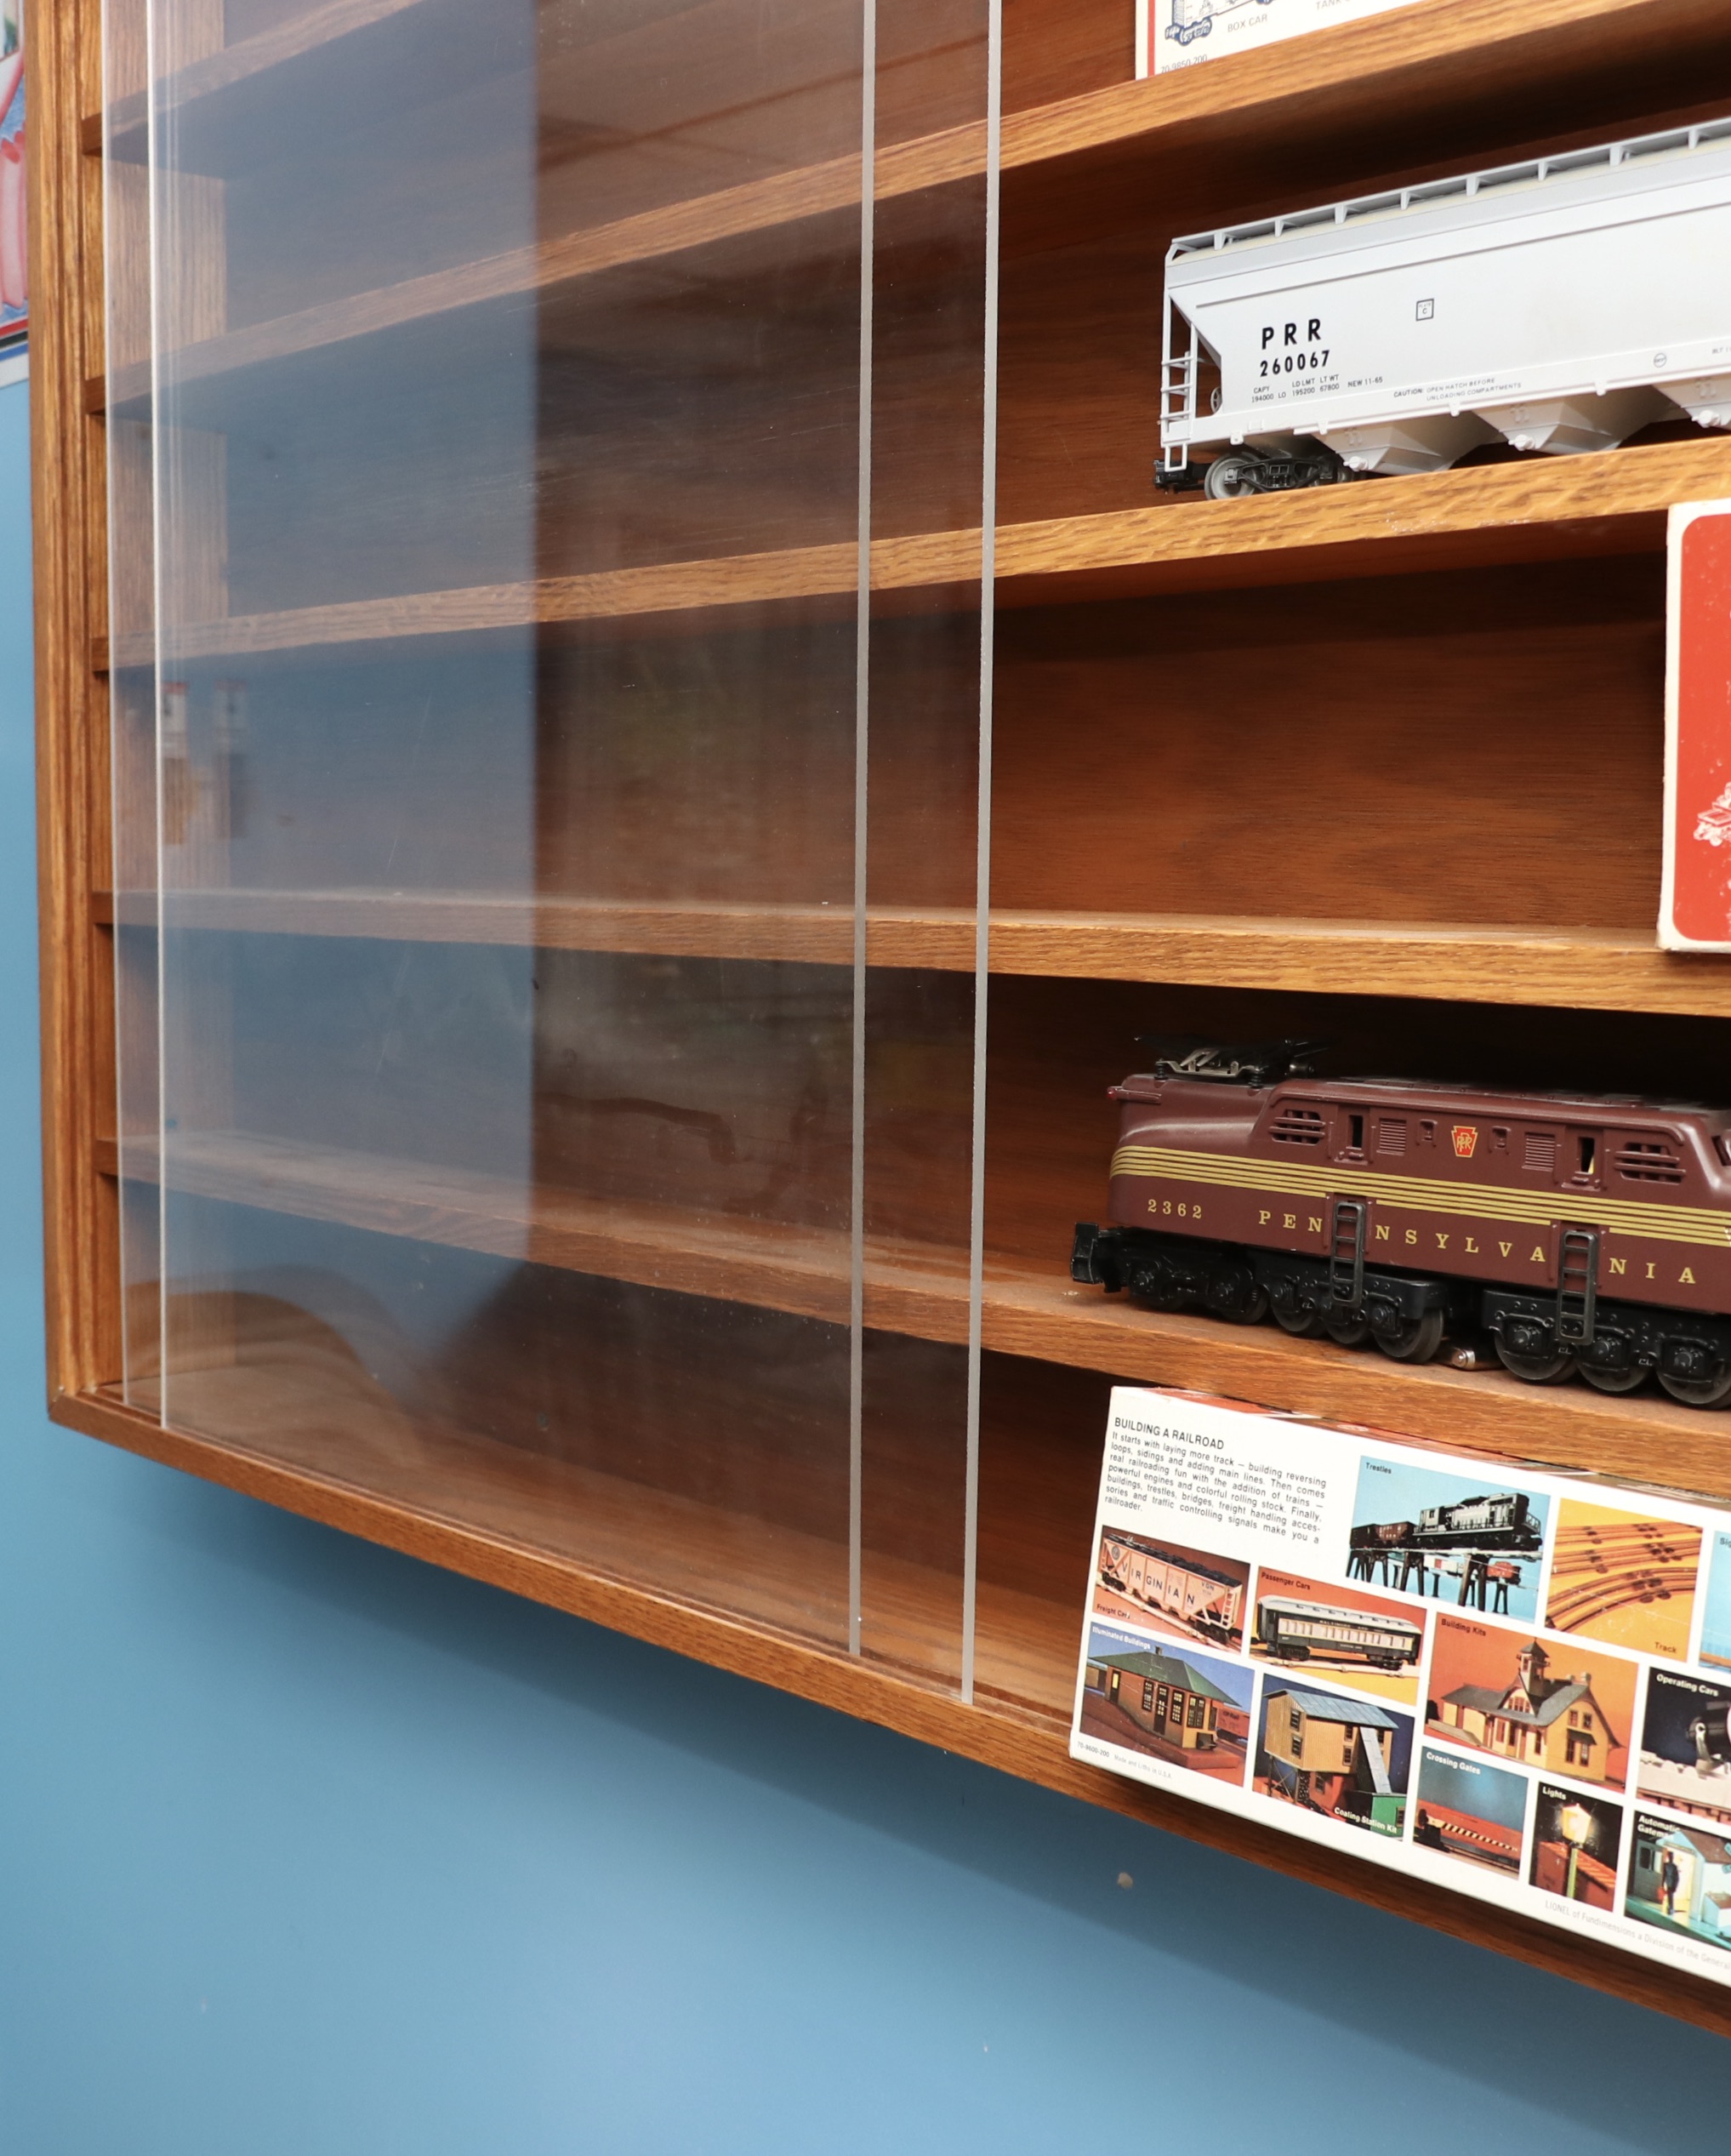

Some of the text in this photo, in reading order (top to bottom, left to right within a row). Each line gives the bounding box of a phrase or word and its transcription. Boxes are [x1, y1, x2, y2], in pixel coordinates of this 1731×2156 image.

[1227, 14, 1268, 32] BOX CAR
[1261, 318, 1321, 350] PRR
[1260, 350, 1330, 377] 260067
[1254, 385, 1270, 394] CAPY
[1301, 378, 1315, 387] LMT
[1329, 374, 1340, 382] WT
[1292, 387, 1315, 396] 195200
[1319, 384, 1340, 392] 67800
[1347, 379, 1363, 388] NEW
[1426, 382, 1522, 402] UNLOADING COMPARTMENTS
[1446, 382, 1467, 391] HATCH
[1469, 378, 1495, 387] BEFORE
[1147, 1198, 1204, 1220] 2362
[1114, 1417, 1224, 1450] BUILDING A RAILROAD
[1113, 1431, 1118, 1440] It
[1120, 1434, 1141, 1446] starts
[1144, 1440, 1160, 1449] with
[1163, 1443, 1187, 1457] laying
[1189, 1451, 1210, 1461] more
[1214, 1455, 1234, 1465] track
[1248, 1462, 1283, 1479] building
[1286, 1472, 1326, 1489] reversing
[1365, 1462, 1392, 1474] Trestles
[1110, 1453, 1125, 1463] real
[1129, 1458, 1170, 1475] railroading
[1175, 1469, 1187, 1478] fun
[1193, 1473, 1209, 1483] with
[1214, 1478, 1227, 1487] the
[1233, 1482, 1266, 1497] addition
[1286, 1494, 1310, 1507] trains
[1137, 1449, 1164, 1463] sidings
[1169, 1457, 1183, 1466] and
[1187, 1461, 1215, 1475] adding
[1219, 1468, 1238, 1479] main
[1271, 1478, 1292, 1491] Then
[1296, 1486, 1325, 1499] comes
[1108, 1464, 1141, 1478] powerful
[1144, 1473, 1174, 1486] engines
[1177, 1481, 1193, 1491] and
[1196, 1486, 1227, 1498] colorful
[1231, 1493, 1257, 1508] rolling
[1261, 1501, 1287, 1513] stock.
[1105, 1496, 1143, 1512] railroader.
[1106, 1486, 1128, 1497] sories
[1133, 1492, 1147, 1502] and
[1152, 1497, 1174, 1509] traffic
[1179, 1504, 1222, 1522] controlling
[1228, 1515, 1257, 1529] signals
[1263, 1524, 1286, 1536] make
[1292, 1531, 1307, 1542] you
[1219, 1501, 1246, 1514] freight
[1250, 1509, 1287, 1526] handling
[1291, 1520, 1320, 1532] acces-
[1122, 1561, 1195, 1605] VIRGINIAN
[1261, 1571, 1311, 1590] Passenger Cars
[1096, 1604, 1116, 1616] Freight
[1092, 1626, 1151, 1650] Illuminated Buildings
[1441, 1618, 1487, 1637] Building Kits
[1654, 1641, 1677, 1654] Track
[1656, 1674, 1719, 1697] Operating Cars
[1426, 1751, 1481, 1775] Crossing Gates
[1542, 1786, 1566, 1800] Lights
[1334, 1807, 1398, 1834] Coaling Station Kit
[1638, 1815, 1680, 1833] Automatic
[1545, 1900, 1569, 1915] LIONEL
[1573, 1910, 1580, 1919] of
[1581, 1914, 1636, 1939] Fundimensions
[1644, 1934, 1675, 1951] Division
[1676, 1945, 1685, 1954] of
[1687, 1948, 1699, 1959] the
